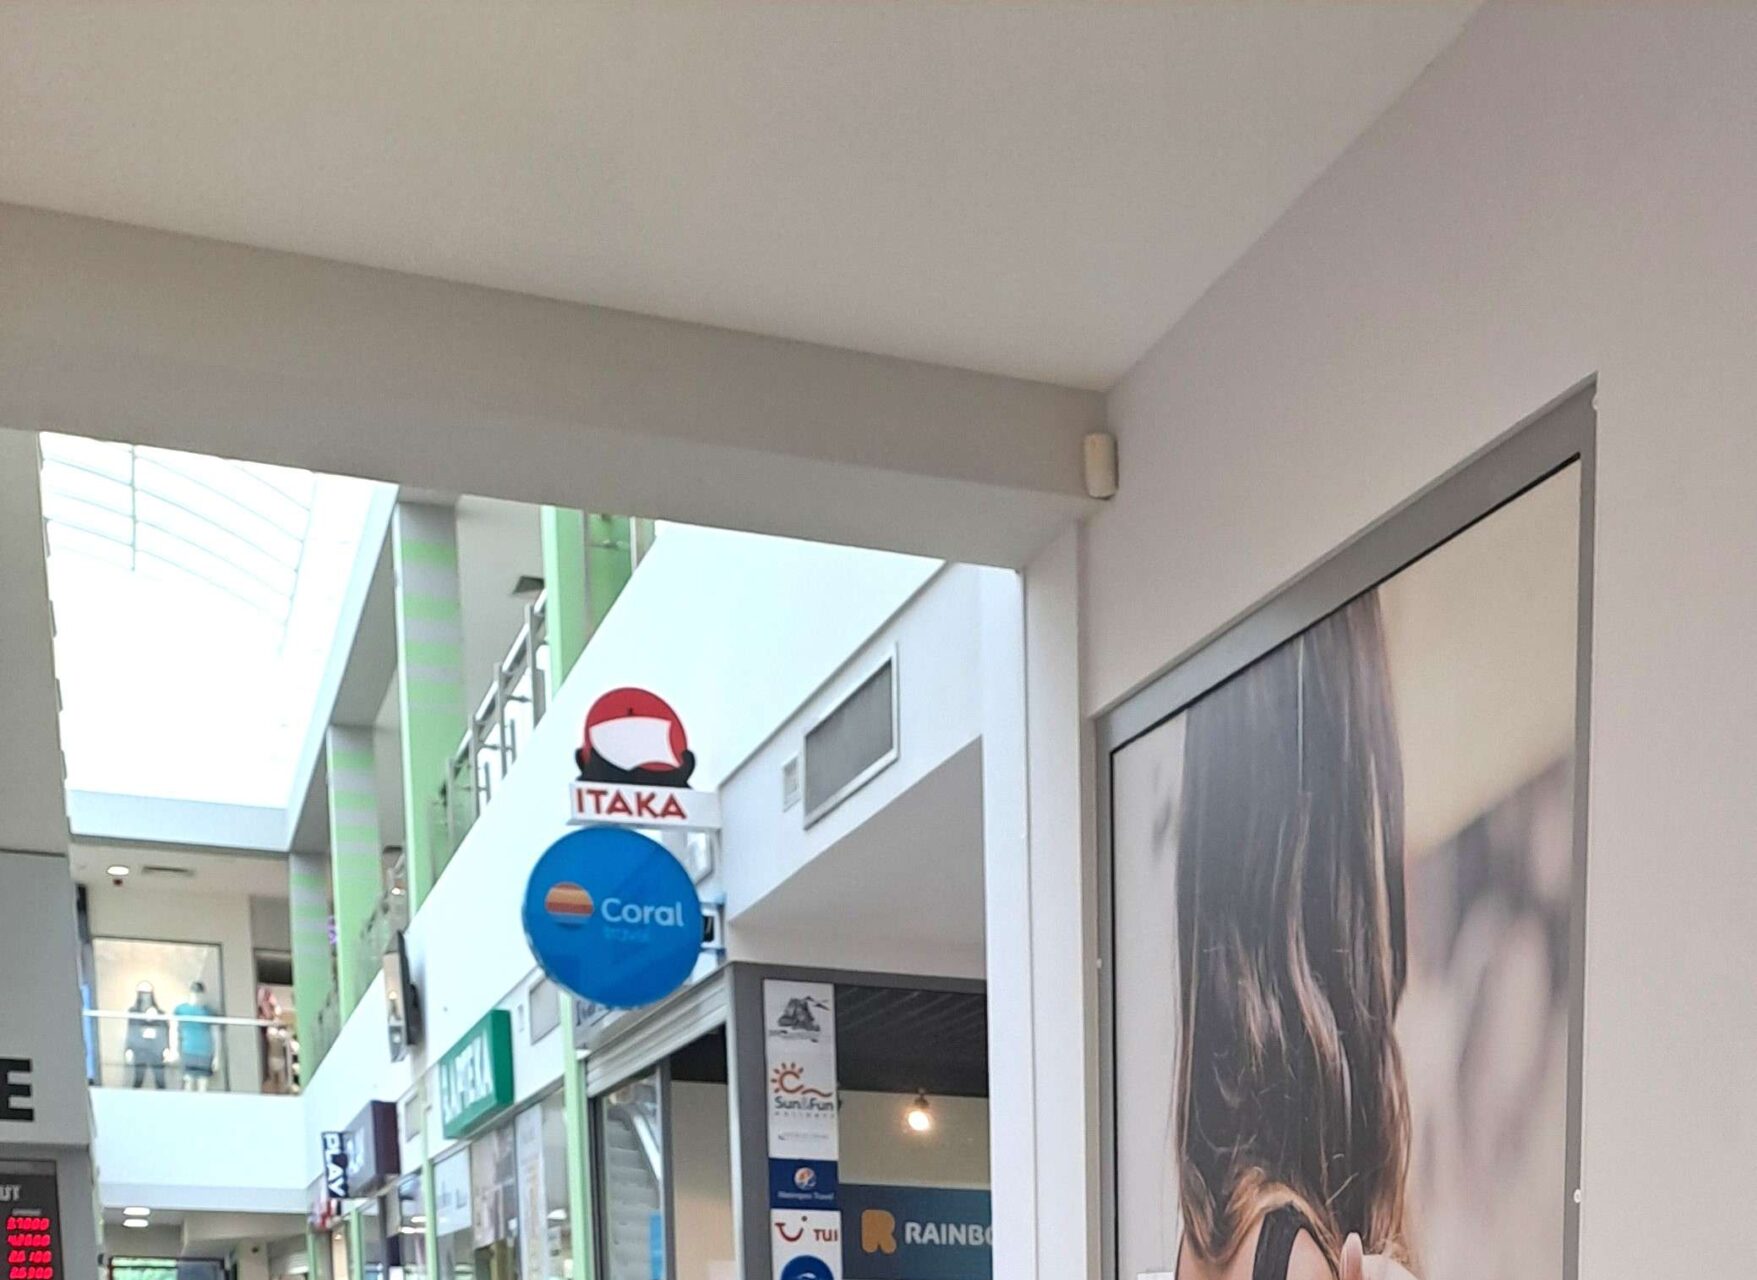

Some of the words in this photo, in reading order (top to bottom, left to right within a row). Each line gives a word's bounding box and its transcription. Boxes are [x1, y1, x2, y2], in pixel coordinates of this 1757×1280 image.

[576, 788, 687, 820] ITAKA
[601, 898, 684, 927] Coral
[0, 1058, 34, 1121] E
[324, 1132, 347, 1197] PLAY
[814, 1229, 838, 1242] TUI
